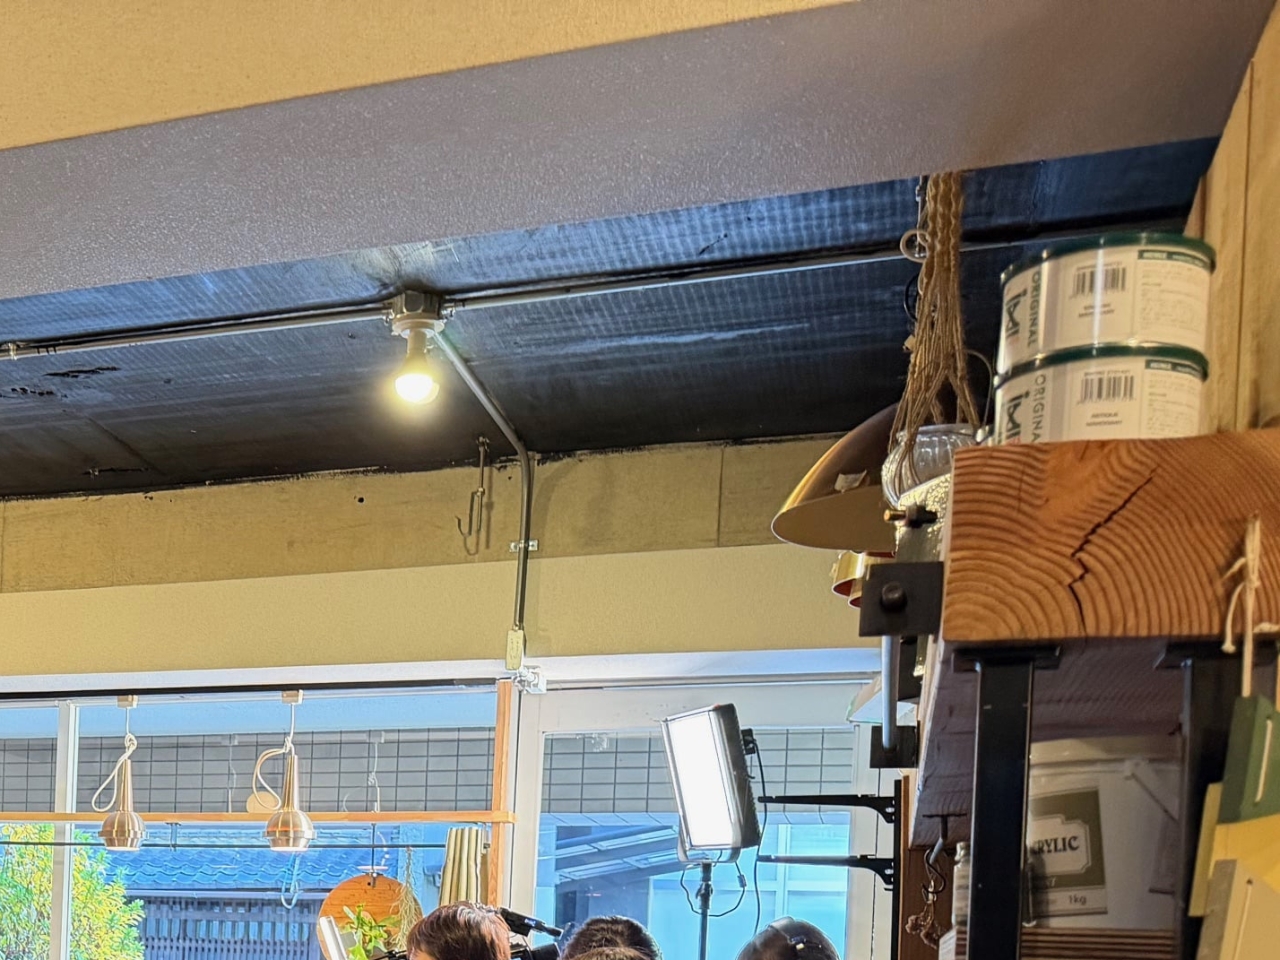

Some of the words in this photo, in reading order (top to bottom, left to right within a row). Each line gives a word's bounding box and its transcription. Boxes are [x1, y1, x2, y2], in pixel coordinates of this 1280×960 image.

[1028, 270, 1041, 347] ORIGINAL
[1031, 374, 1047, 442] ORIGINA
[1068, 893, 1087, 906] 1kg
